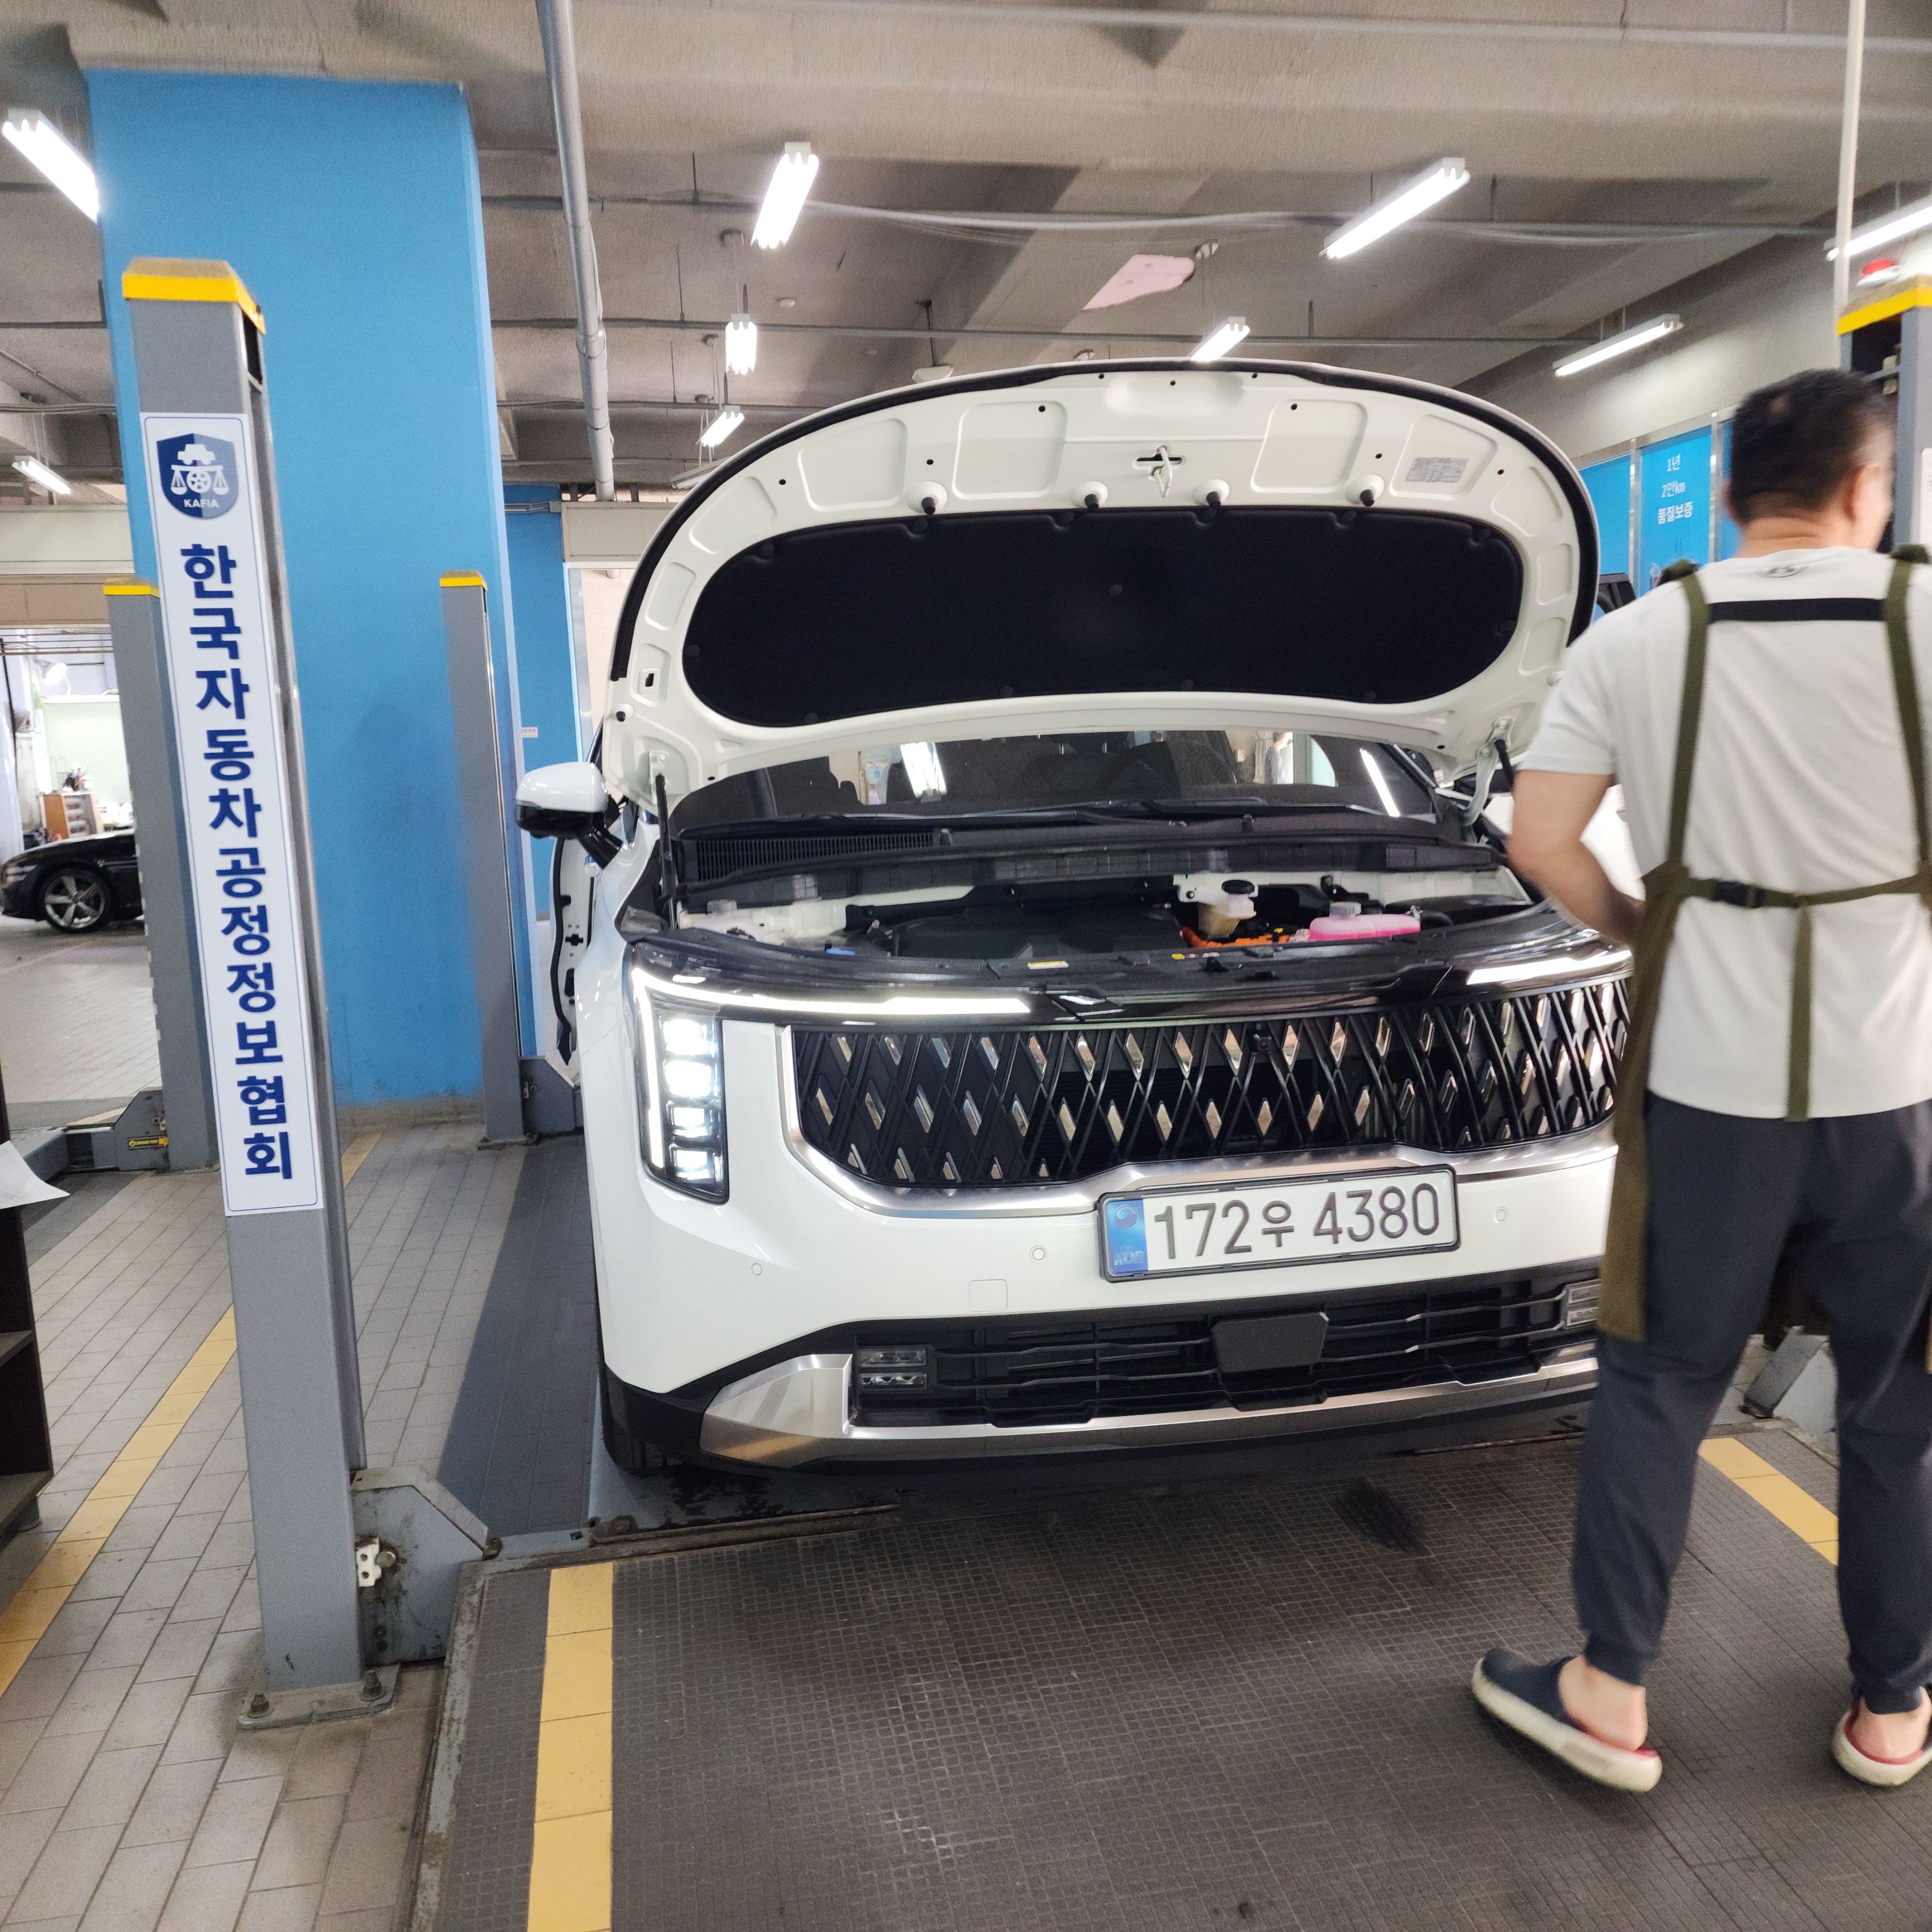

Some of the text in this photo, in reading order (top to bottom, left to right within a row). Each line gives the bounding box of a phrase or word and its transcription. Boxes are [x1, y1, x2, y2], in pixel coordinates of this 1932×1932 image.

[1666, 453, 1681, 472] 1년
[183, 499, 220, 508] KAFIA
[1657, 501, 1693, 525] 품질보증
[180, 543, 292, 1180] 한국자동차공정정보협회
[1154, 1182, 1440, 1260] 172우 4380
[1114, 1250, 1144, 1266] KOR
